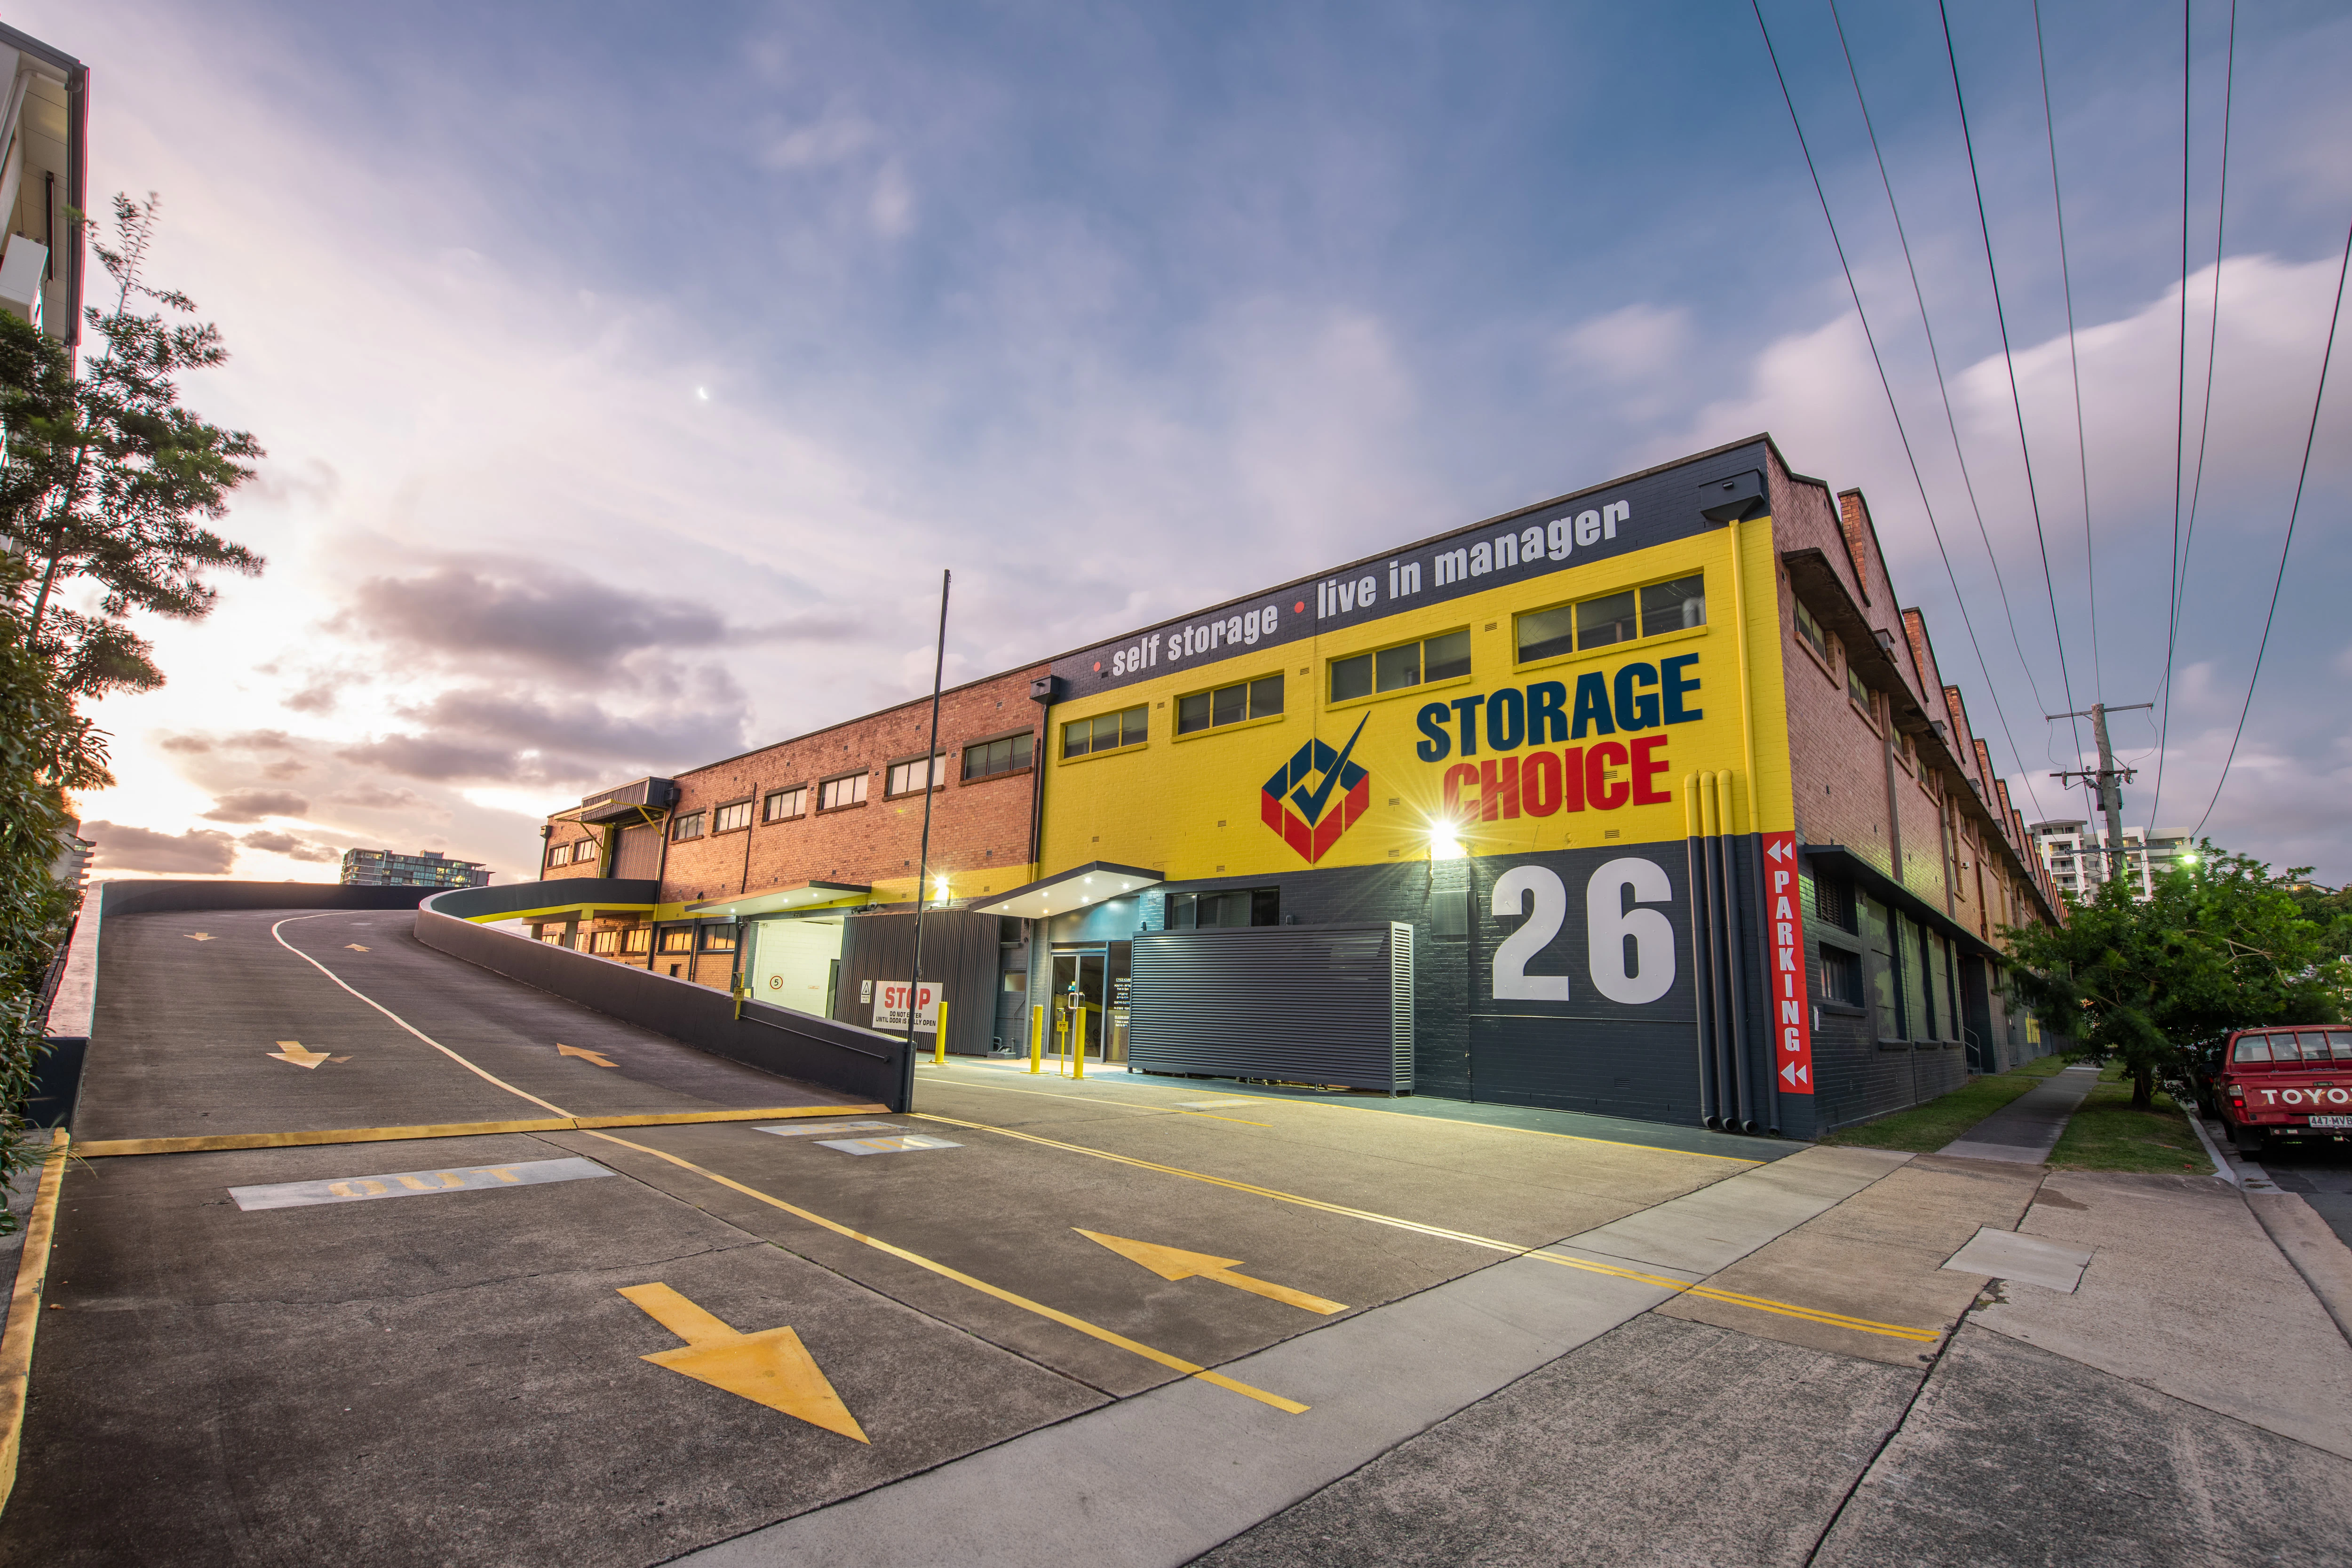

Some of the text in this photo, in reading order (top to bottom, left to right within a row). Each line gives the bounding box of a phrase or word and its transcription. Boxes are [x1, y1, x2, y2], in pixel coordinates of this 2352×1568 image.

[1112, 500, 1630, 677] self storage live in manager
[1416, 652, 1703, 824] STORAGE CHOICE
[884, 987, 931, 1010] STOP
[1492, 857, 1676, 1005] 26
[1773, 870, 1800, 1052] PARKING
[2260, 1088, 2352, 1104] TOYO
[327, 1167, 521, 1197] OUT
